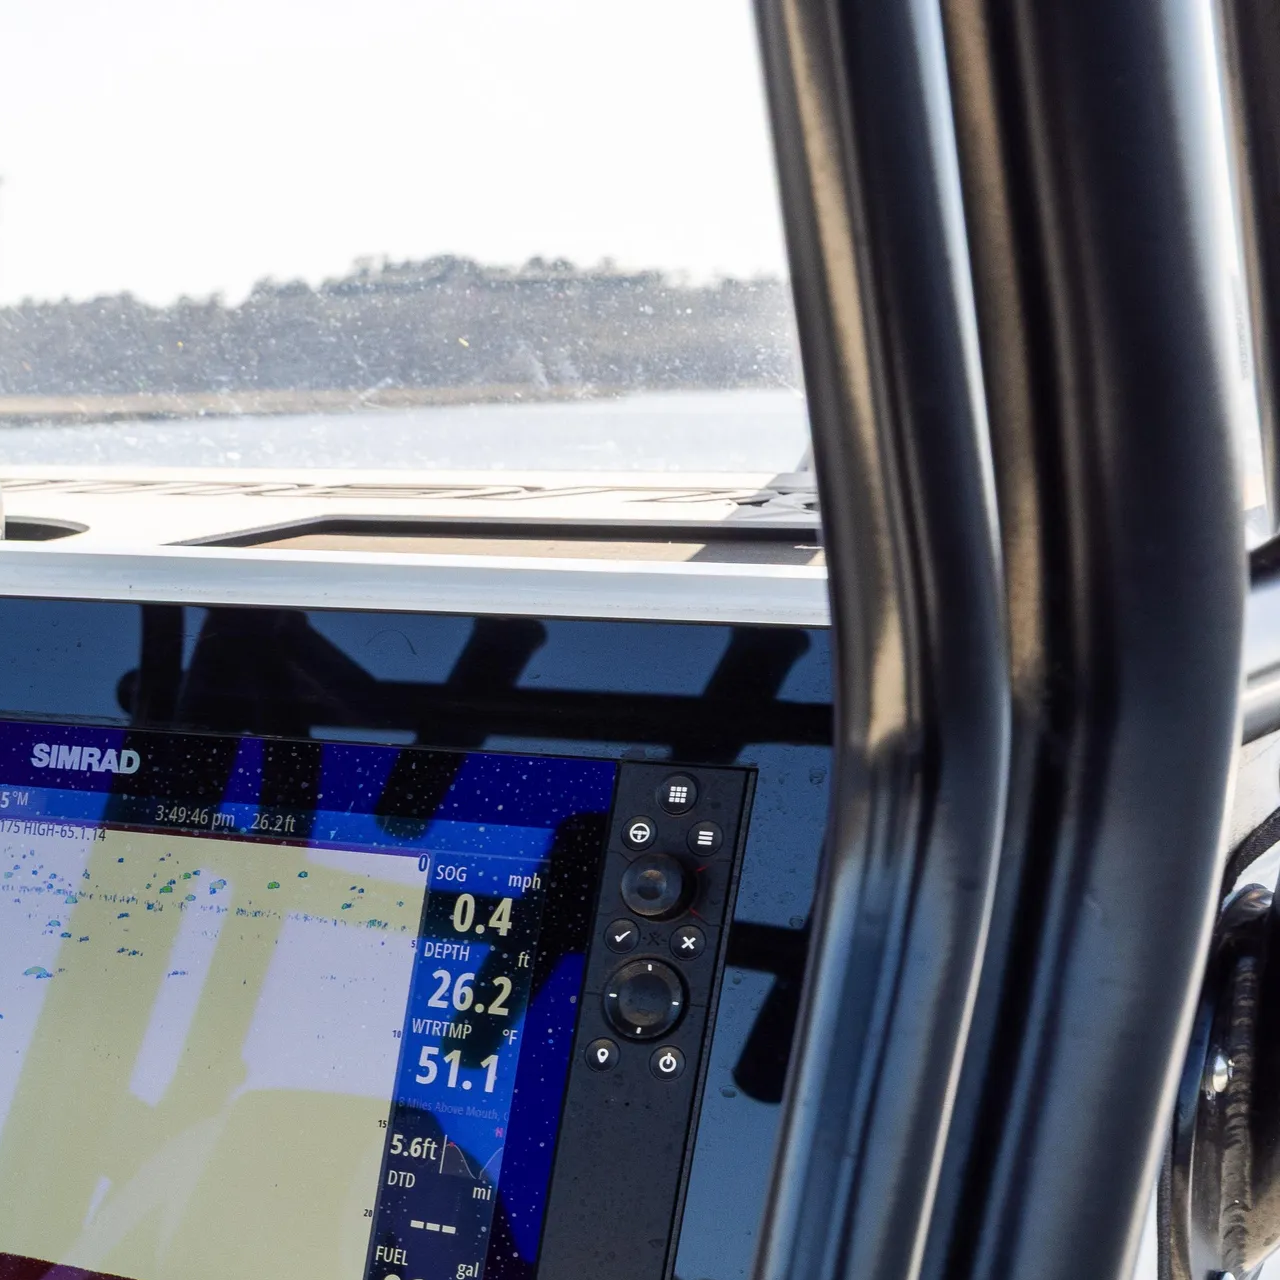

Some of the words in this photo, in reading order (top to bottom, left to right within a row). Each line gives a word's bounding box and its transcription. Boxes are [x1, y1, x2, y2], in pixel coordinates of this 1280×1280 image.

[30, 743, 139, 775] SIMRAD
[12, 791, 28, 806] °M
[155, 805, 208, 825] 3:49:46
[212, 810, 235, 828] pm
[22, 821, 107, 842] HIGH-65.1.14
[418, 854, 429, 873] 0
[436, 864, 468, 882] SOG
[508, 873, 541, 892] mph
[452, 893, 513, 937] 0.4
[424, 941, 470, 962] DEPTH
[517, 951, 531, 968] ft
[427, 969, 513, 1016] 26.2
[392, 1029, 402, 1039] 10
[412, 1018, 473, 1040] WTRTMP
[502, 1029, 518, 1046] °F
[415, 1045, 499, 1093] 51.1
[406, 1098, 433, 1112] Miles
[435, 1101, 463, 1117] Above
[378, 1119, 388, 1129] 15
[390, 1133, 438, 1161] 5.6ft
[387, 1170, 416, 1189] DTD
[472, 1185, 492, 1201] mi
[363, 1208, 373, 1219] 20
[375, 1245, 409, 1267] FUEL
[456, 1262, 480, 1280] gal
